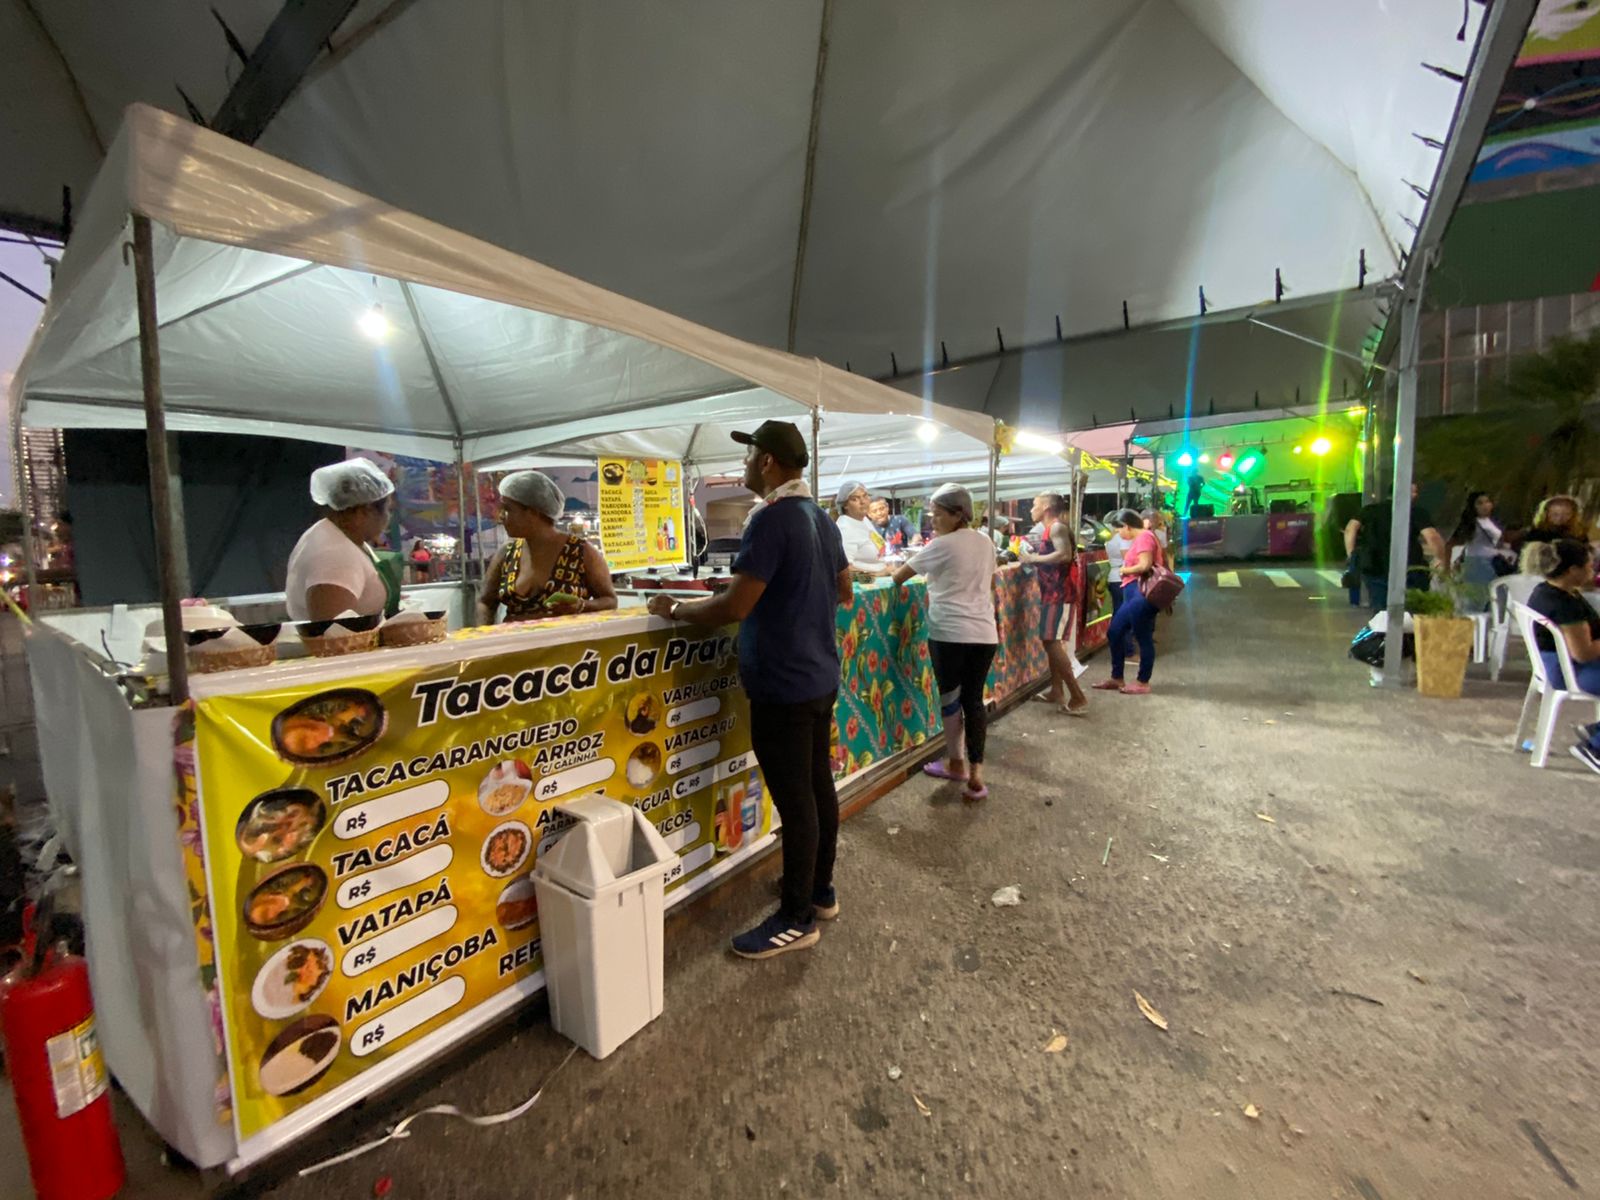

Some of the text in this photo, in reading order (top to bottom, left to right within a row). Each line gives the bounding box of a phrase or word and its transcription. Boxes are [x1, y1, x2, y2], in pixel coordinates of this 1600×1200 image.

[412, 649, 600, 726] Tacacá
[607, 644, 659, 683] da
[670, 712, 681, 723] R$
[326, 719, 578, 803] TACACARANGUEJO
[534, 732, 604, 767] ARROZ
[541, 751, 597, 774] C/ GALINHA
[670, 758, 681, 770] R$
[542, 780, 558, 796] R$
[689, 776, 700, 788] R$
[346, 811, 367, 832] R$
[656, 808, 692, 834] UCOS
[332, 814, 450, 876] TACACÁ
[671, 864, 681, 877] R$
[348, 879, 371, 900] R$
[337, 878, 451, 945] VATAPÁ
[353, 946, 376, 969] R$
[500, 937, 542, 977] REF
[345, 927, 497, 1022] MANIÇOBA
[362, 1024, 385, 1048] R$
